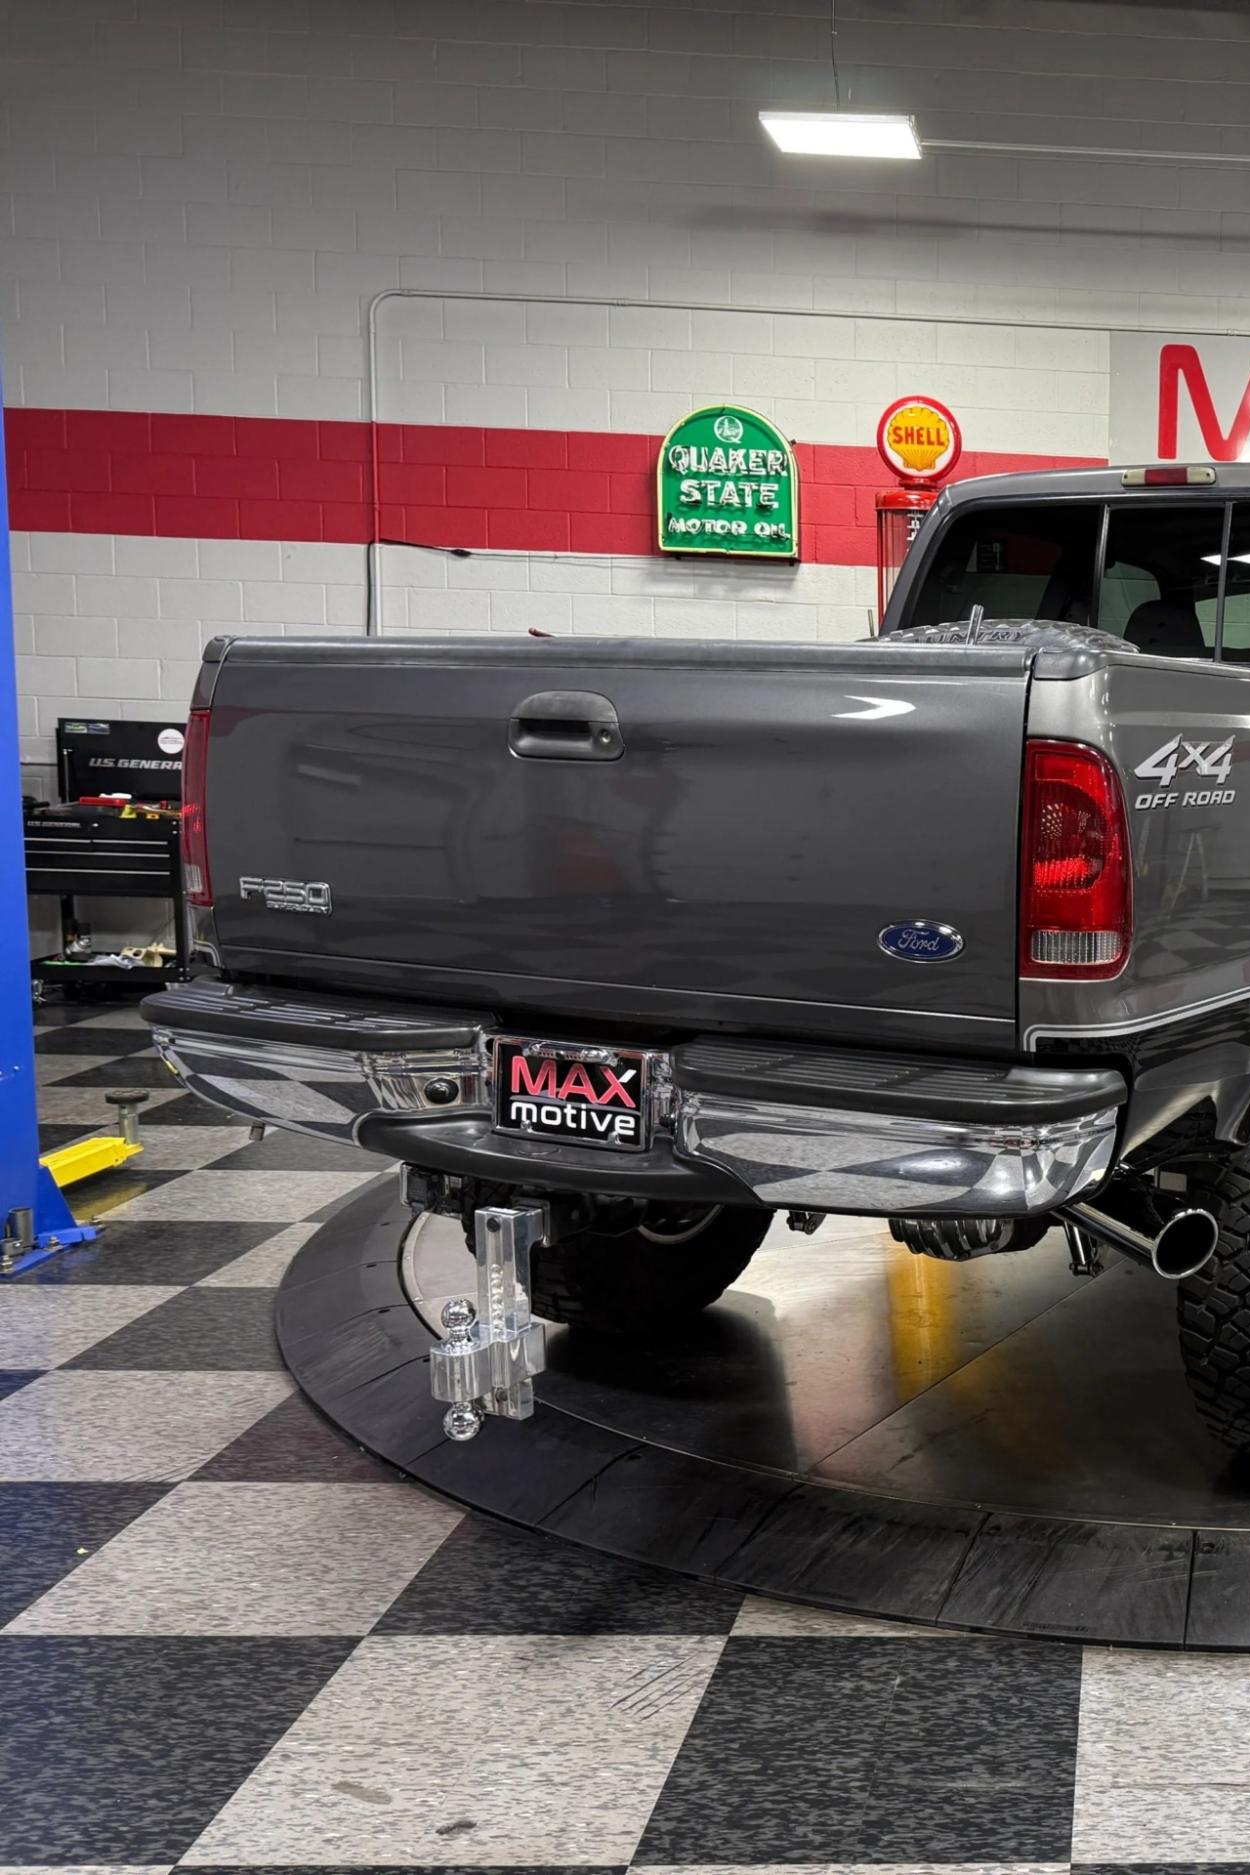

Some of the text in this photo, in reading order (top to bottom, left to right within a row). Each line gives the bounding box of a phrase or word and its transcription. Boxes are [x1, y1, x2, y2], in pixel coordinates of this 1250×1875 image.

[892, 425, 946, 446] SHELL
[668, 445, 789, 477] QUAKER
[679, 479, 780, 509] STATE
[668, 517, 791, 538] MOTOR OIL
[1134, 790, 1237, 811] OFF ROAD
[897, 929, 941, 951] Ford
[511, 1055, 638, 1109] MAX
[509, 1101, 636, 1137] motive
